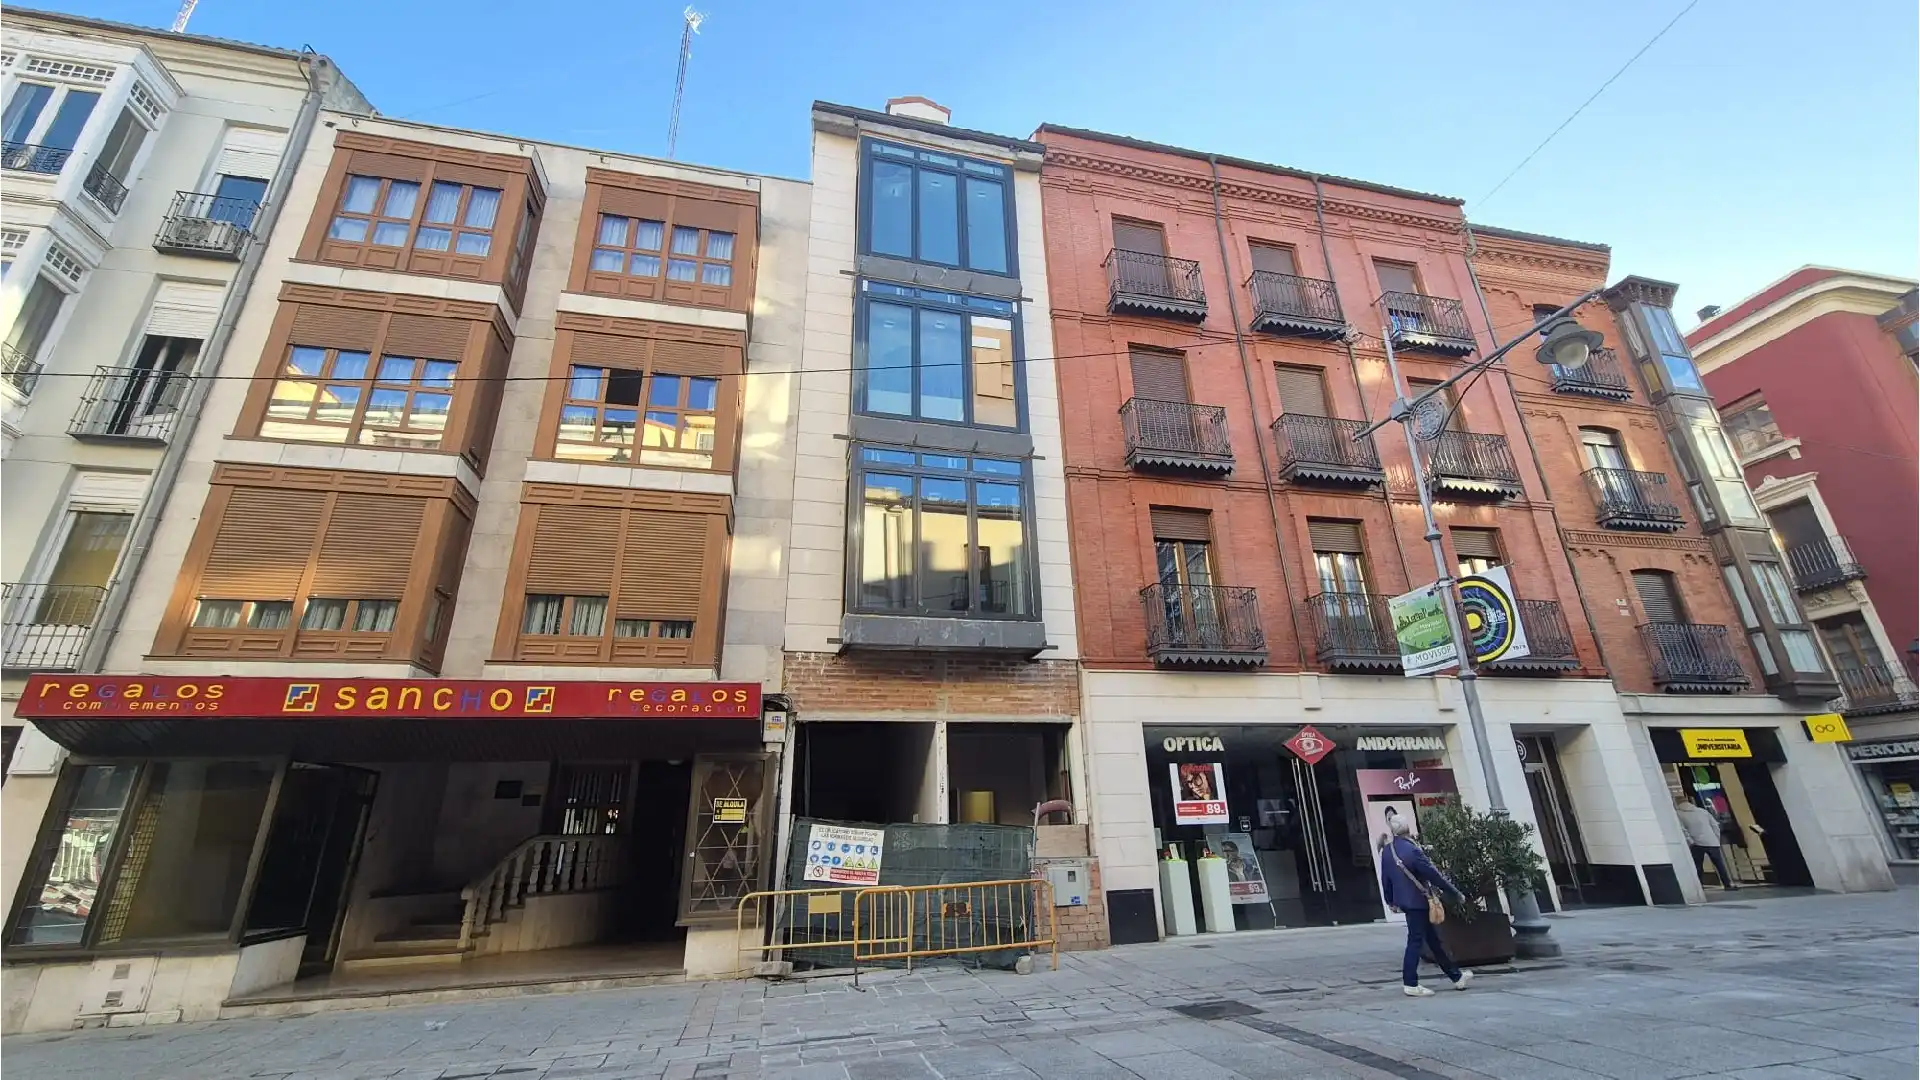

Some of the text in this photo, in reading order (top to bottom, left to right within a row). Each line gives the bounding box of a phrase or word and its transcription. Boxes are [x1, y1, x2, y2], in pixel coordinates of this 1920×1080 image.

[62, 700, 219, 710] comemenos
[1163, 736, 1225, 752] OPTICA
[1356, 736, 1446, 751] ANDORRANA
